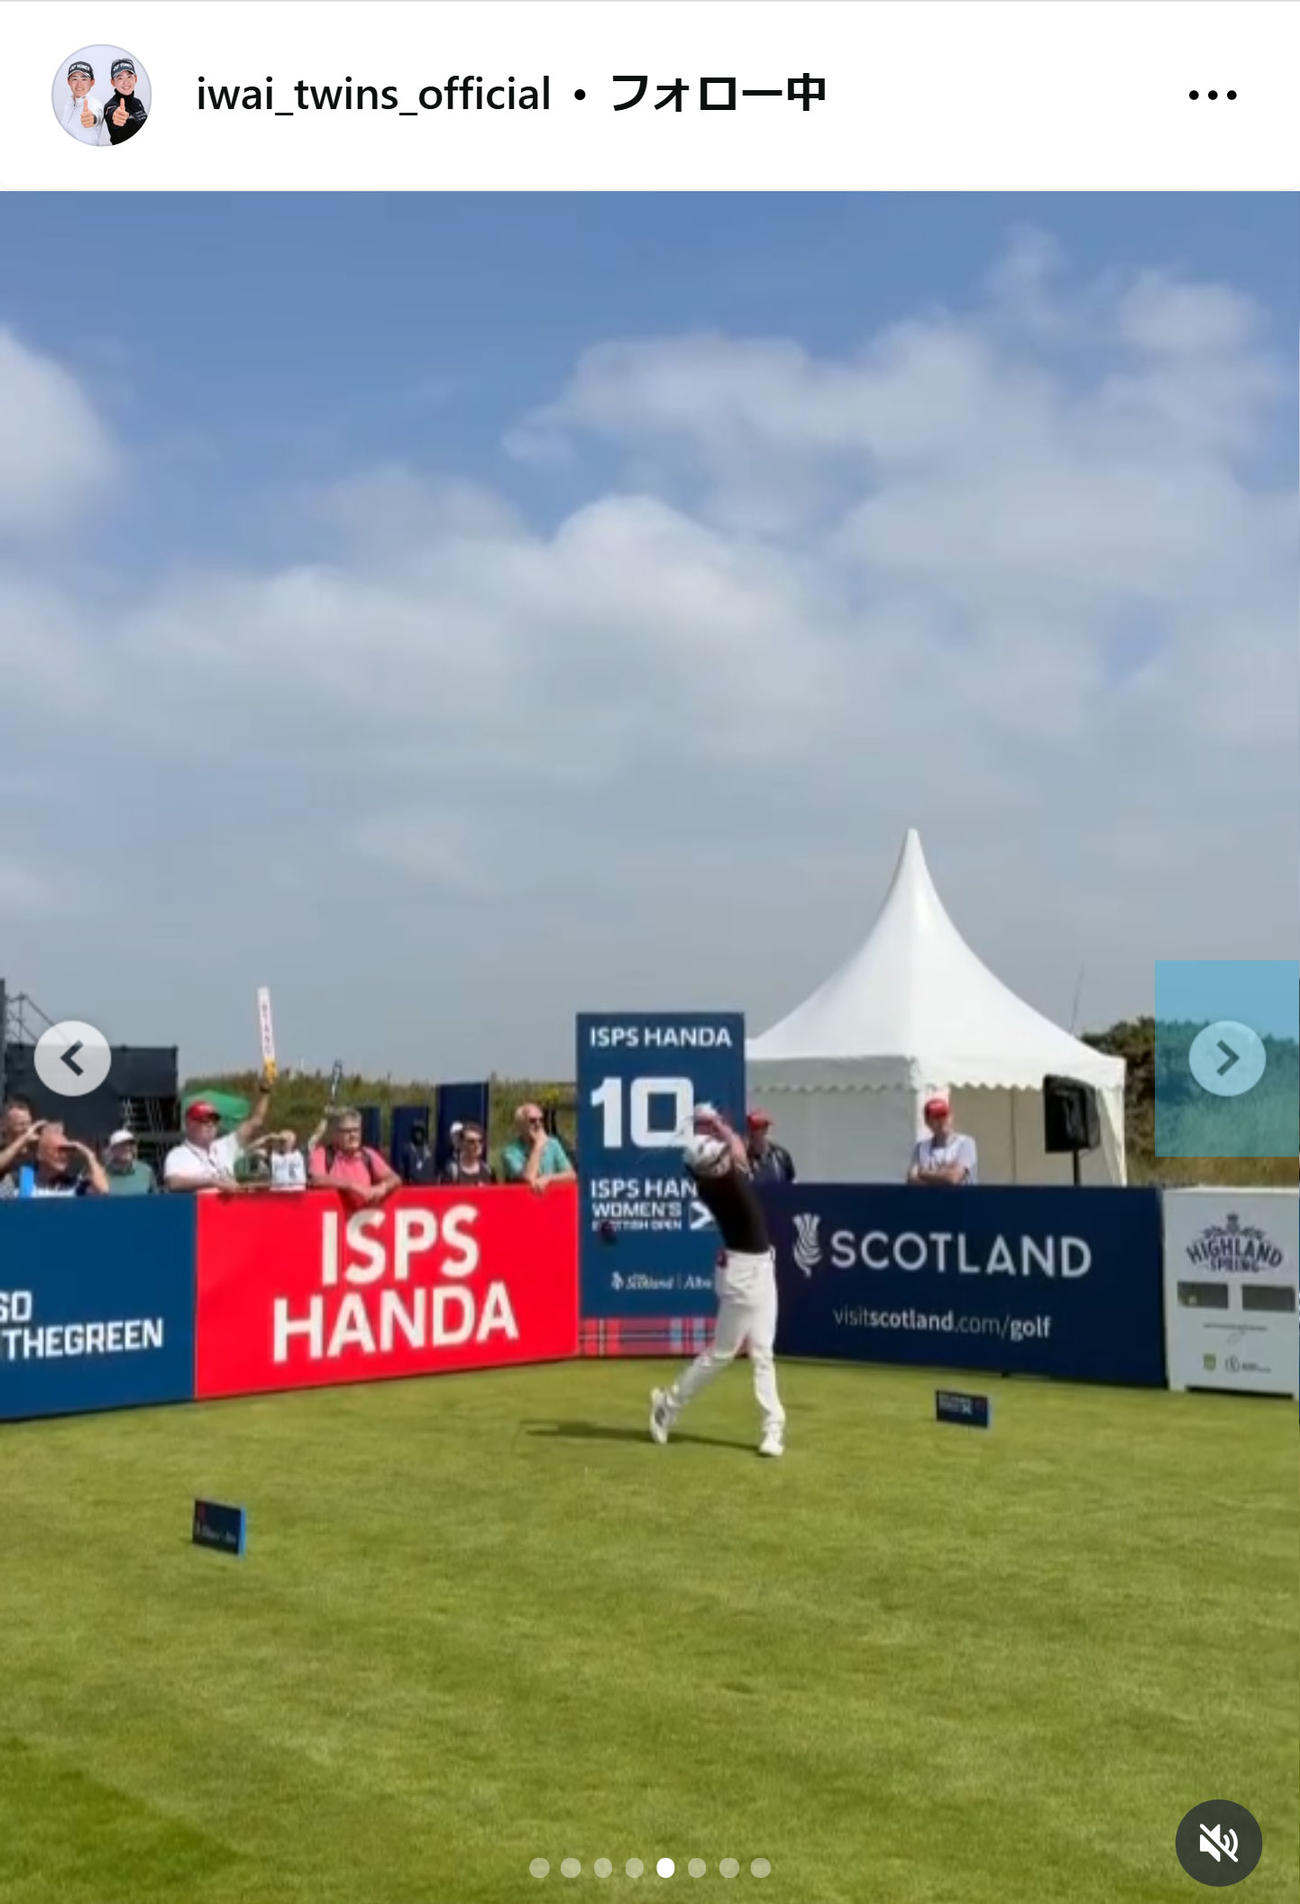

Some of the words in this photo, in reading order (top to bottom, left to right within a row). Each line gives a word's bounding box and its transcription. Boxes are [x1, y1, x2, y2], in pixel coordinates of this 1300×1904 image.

[590, 1026, 639, 1047] ISPS
[644, 1026, 733, 1047] HANDA
[590, 1076, 694, 1148] 10
[591, 1178, 640, 1199] ISPS
[644, 1178, 698, 1199] HAN
[592, 1201, 682, 1217] WOMEN'S
[322, 1203, 480, 1287] ISPS
[830, 1230, 1092, 1279] SCOTLAND
[1186, 1237, 1284, 1269] HIGHLAND
[1210, 1257, 1260, 1274] SPRING
[1, 1316, 164, 1361] THEGREEN
[273, 1280, 520, 1364] HANDA
[832, 1304, 1053, 1342] visitscotland.com/golf
